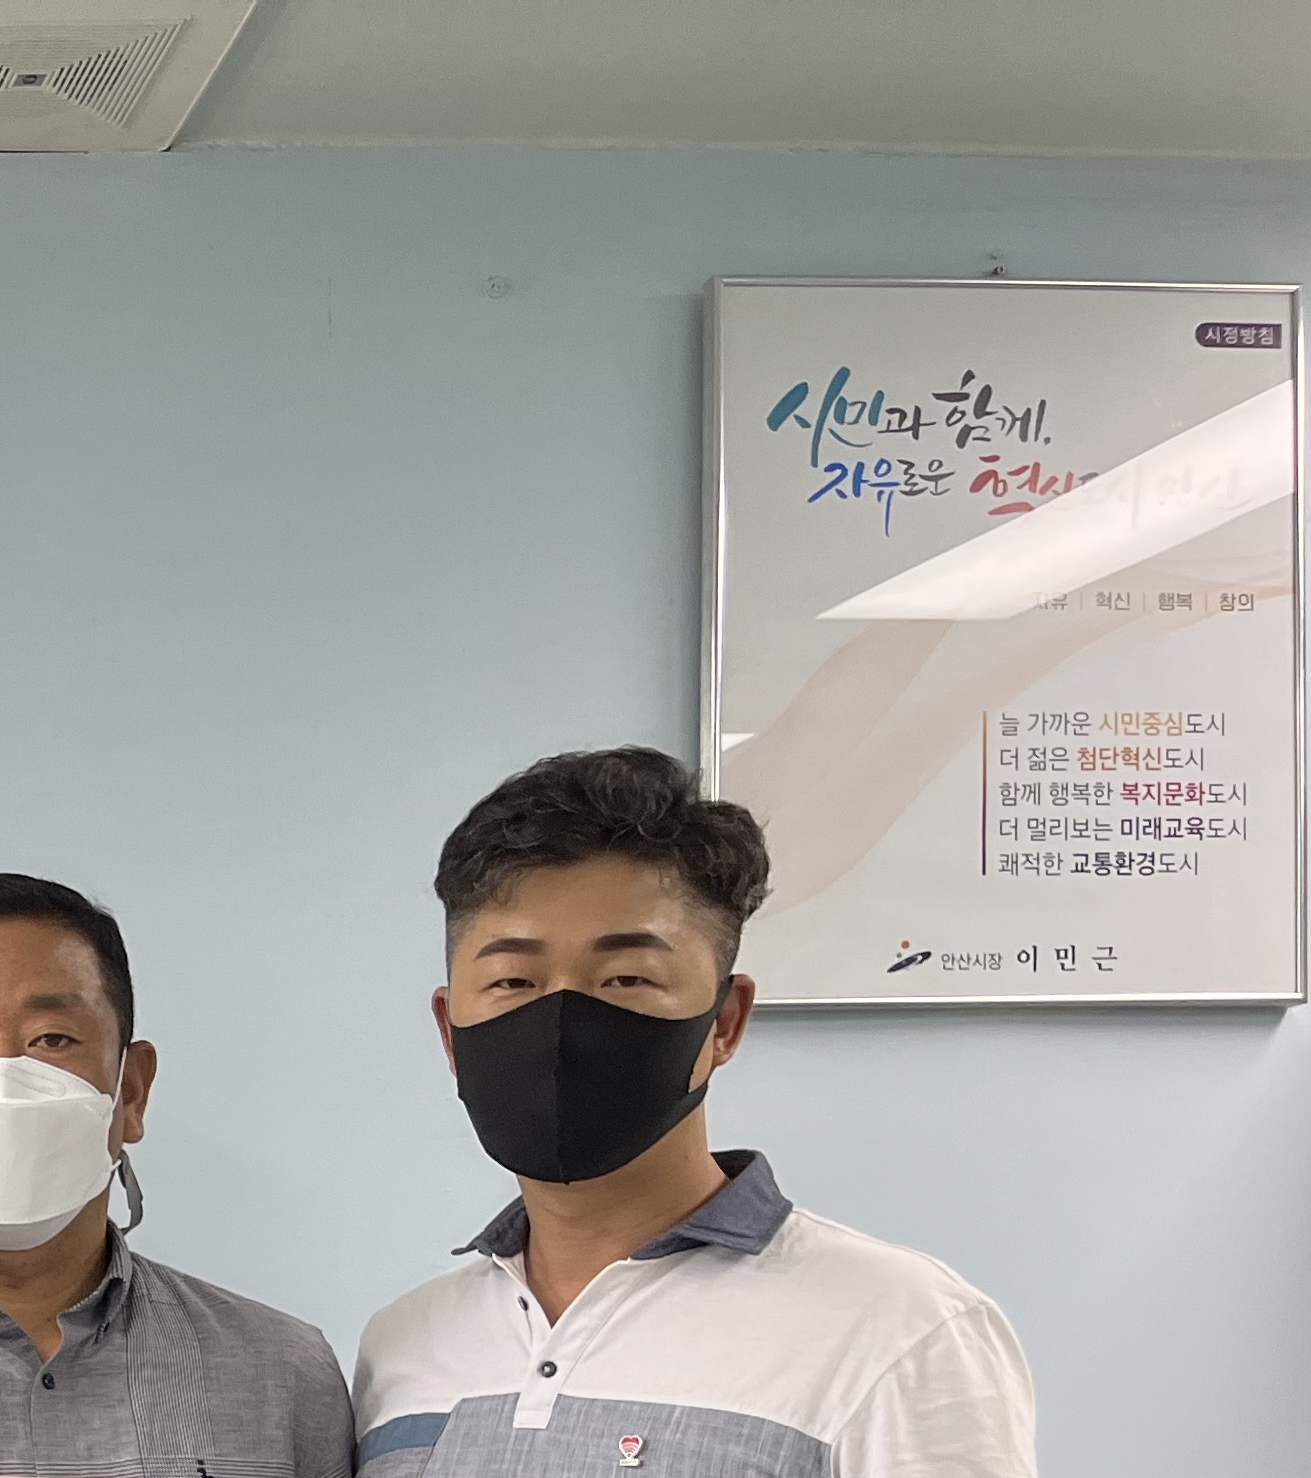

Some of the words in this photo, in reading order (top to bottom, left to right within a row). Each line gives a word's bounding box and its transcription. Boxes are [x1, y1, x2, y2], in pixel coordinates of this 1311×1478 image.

[1205, 326, 1274, 345] 시정방침
[766, 366, 937, 468] 시민과
[807, 457, 956, 537] 자유로운
[1095, 591, 1131, 611] 혁신
[1157, 592, 1193, 611] 행복
[1219, 593, 1255, 612] 창의
[999, 712, 1019, 736] 늘
[1028, 711, 1092, 736] 가까운
[1098, 711, 1226, 736] 시민중심도시
[999, 748, 1019, 771] 더
[1027, 748, 1070, 772] 젊은
[1077, 746, 1205, 772] 첨단혁신도시
[999, 782, 1041, 805] 함께
[1049, 781, 1113, 807] 행복한
[1120, 781, 1247, 807] 복지문화도시
[999, 819, 1019, 841] 더
[1026, 818, 1113, 842] 멀리보는
[1121, 817, 1248, 842] 미래교육도시
[998, 852, 1063, 876] 쾌적한
[1070, 852, 1199, 876] 교통환경도시
[941, 952, 1003, 972] 안산시장
